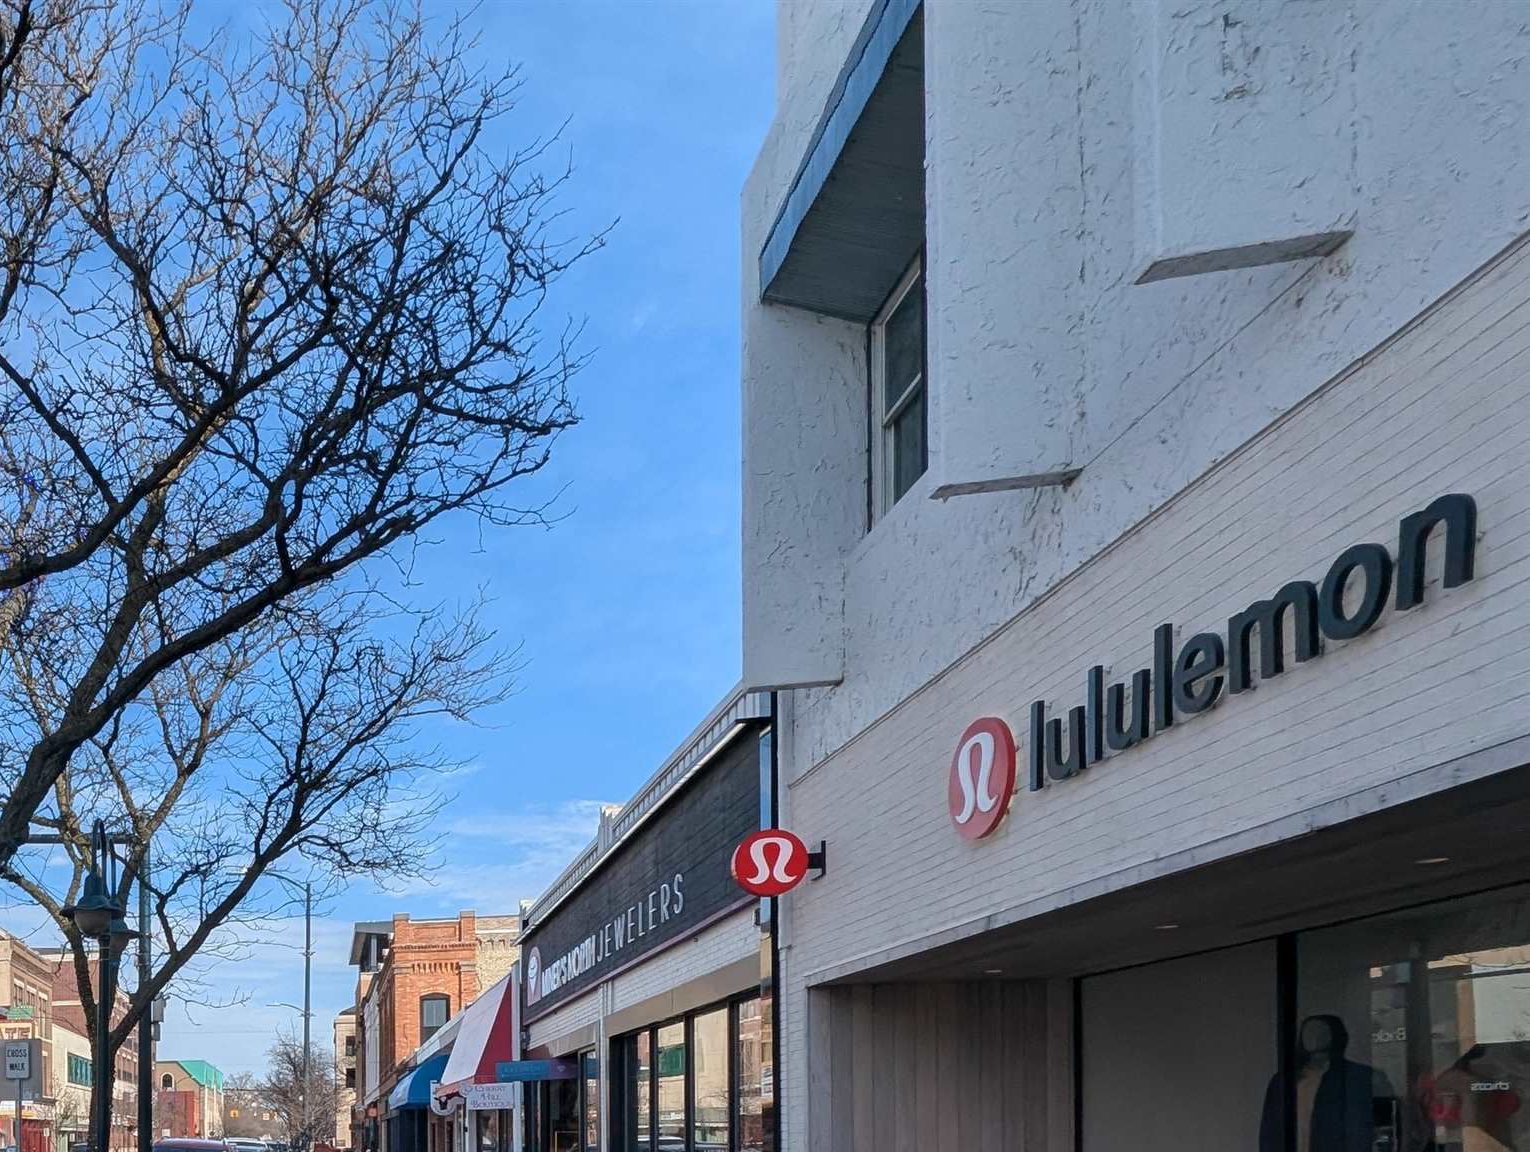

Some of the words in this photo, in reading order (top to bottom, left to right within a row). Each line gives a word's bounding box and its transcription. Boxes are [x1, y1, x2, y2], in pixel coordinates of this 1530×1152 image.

[1029, 492, 1477, 792] lululemon
[597, 873, 684, 963] JEWELERS
[7, 1048, 27, 1058] CROSS
[9, 1063, 26, 1071] WALK
